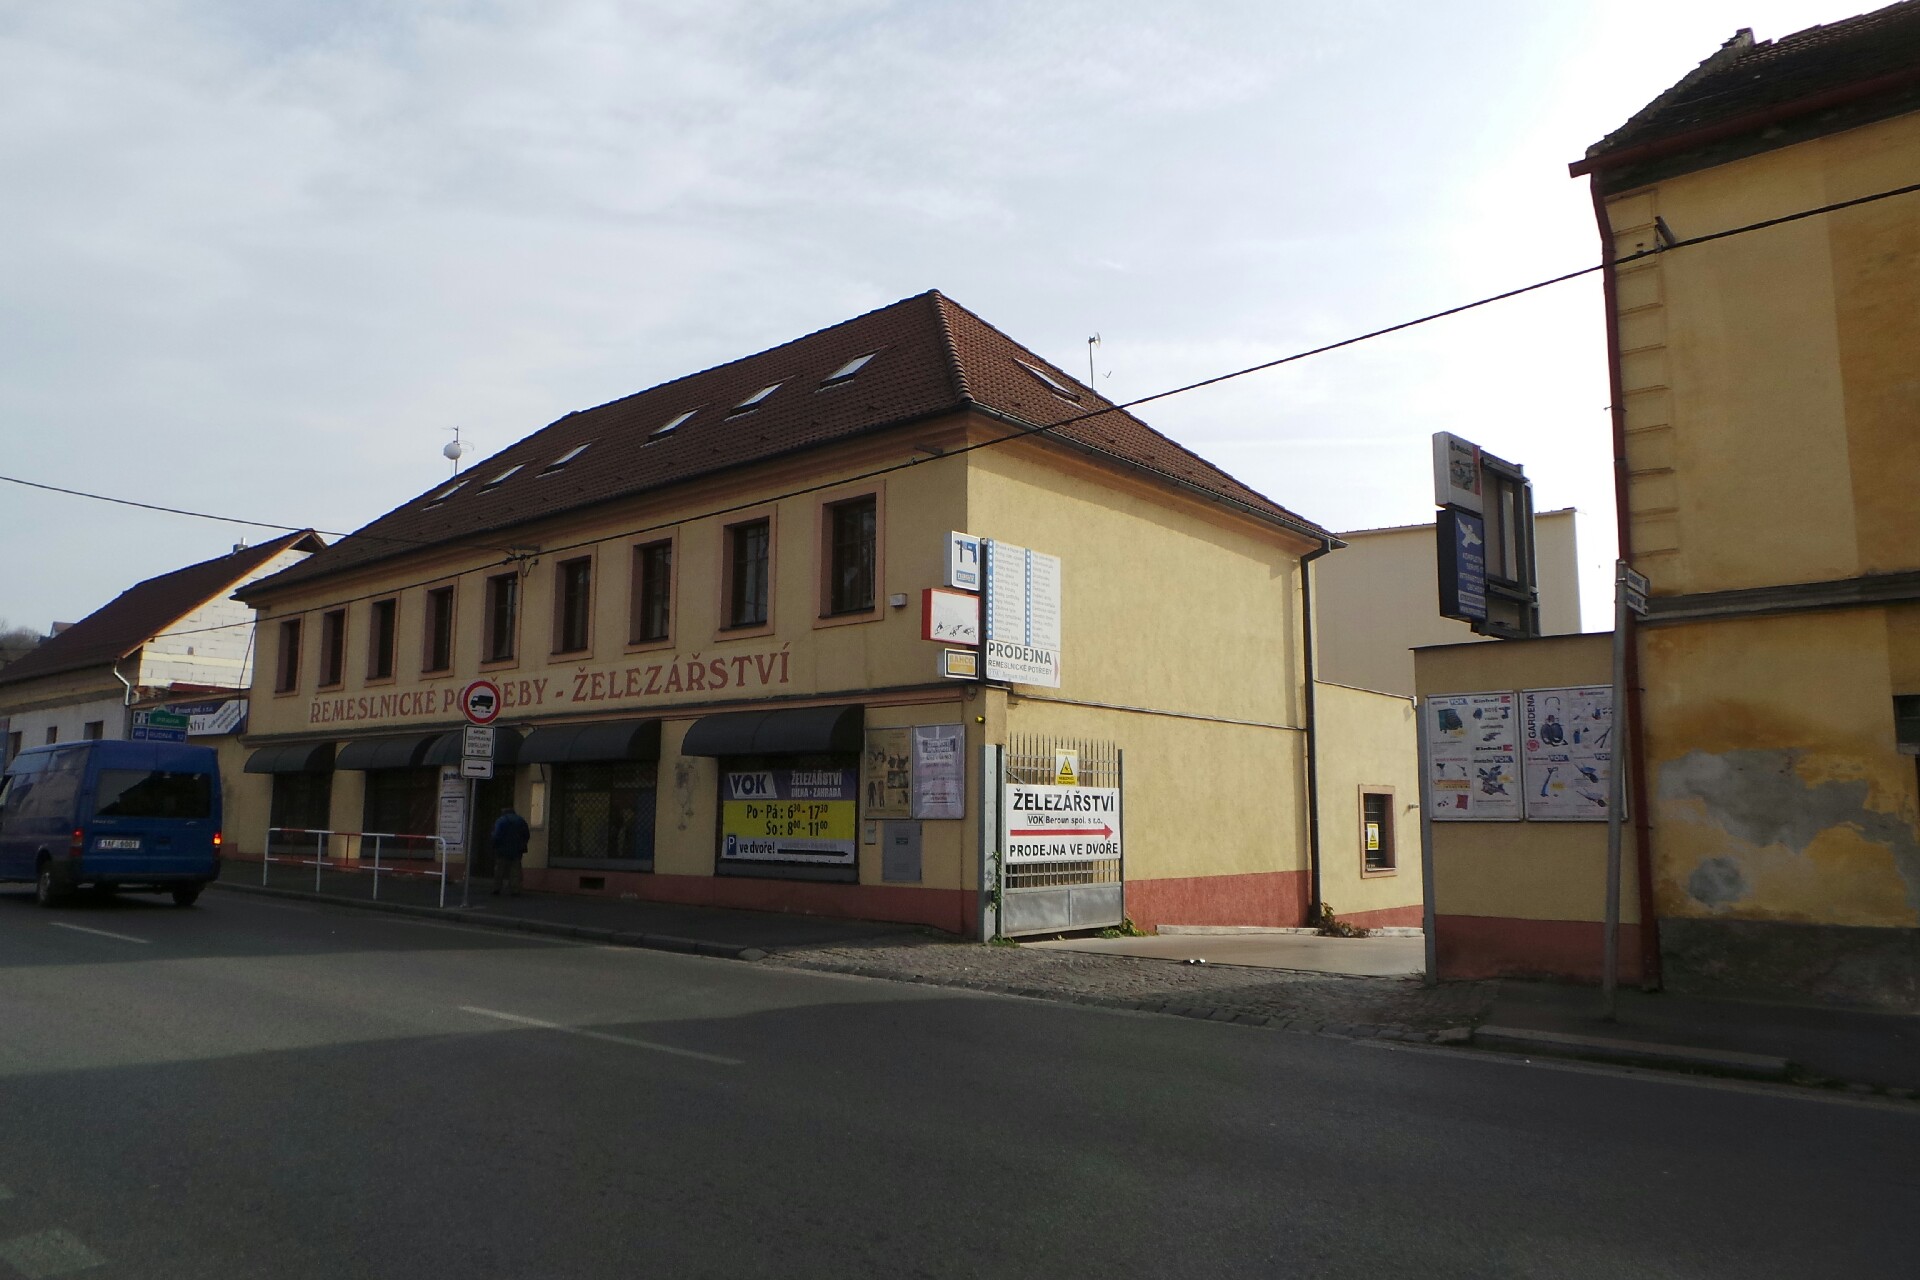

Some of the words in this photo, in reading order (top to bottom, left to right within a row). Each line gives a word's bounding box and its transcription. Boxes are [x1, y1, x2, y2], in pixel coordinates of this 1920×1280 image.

[988, 642, 1052, 666] PRODEJNA
[309, 683, 437, 723] ŘEMESLNICKÉ
[571, 641, 791, 702] ŽELEZÁŘSTVÍ
[1527, 694, 1537, 739] GARDENA
[728, 773, 768, 795] VOK
[1013, 788, 1114, 812] ŽELEZÁŘSTVÍ
[746, 804, 758, 820] Po
[1028, 815, 1044, 825] VOK
[1045, 815, 1069, 825] Beroun
[1070, 815, 1087, 826] spol.
[739, 843, 749, 854] ve
[750, 841, 775, 854] dvoře!
[1009, 844, 1067, 857] PRODEJNA
[1070, 844, 1083, 855] VE
[1086, 841, 1118, 855] DVOŘE
